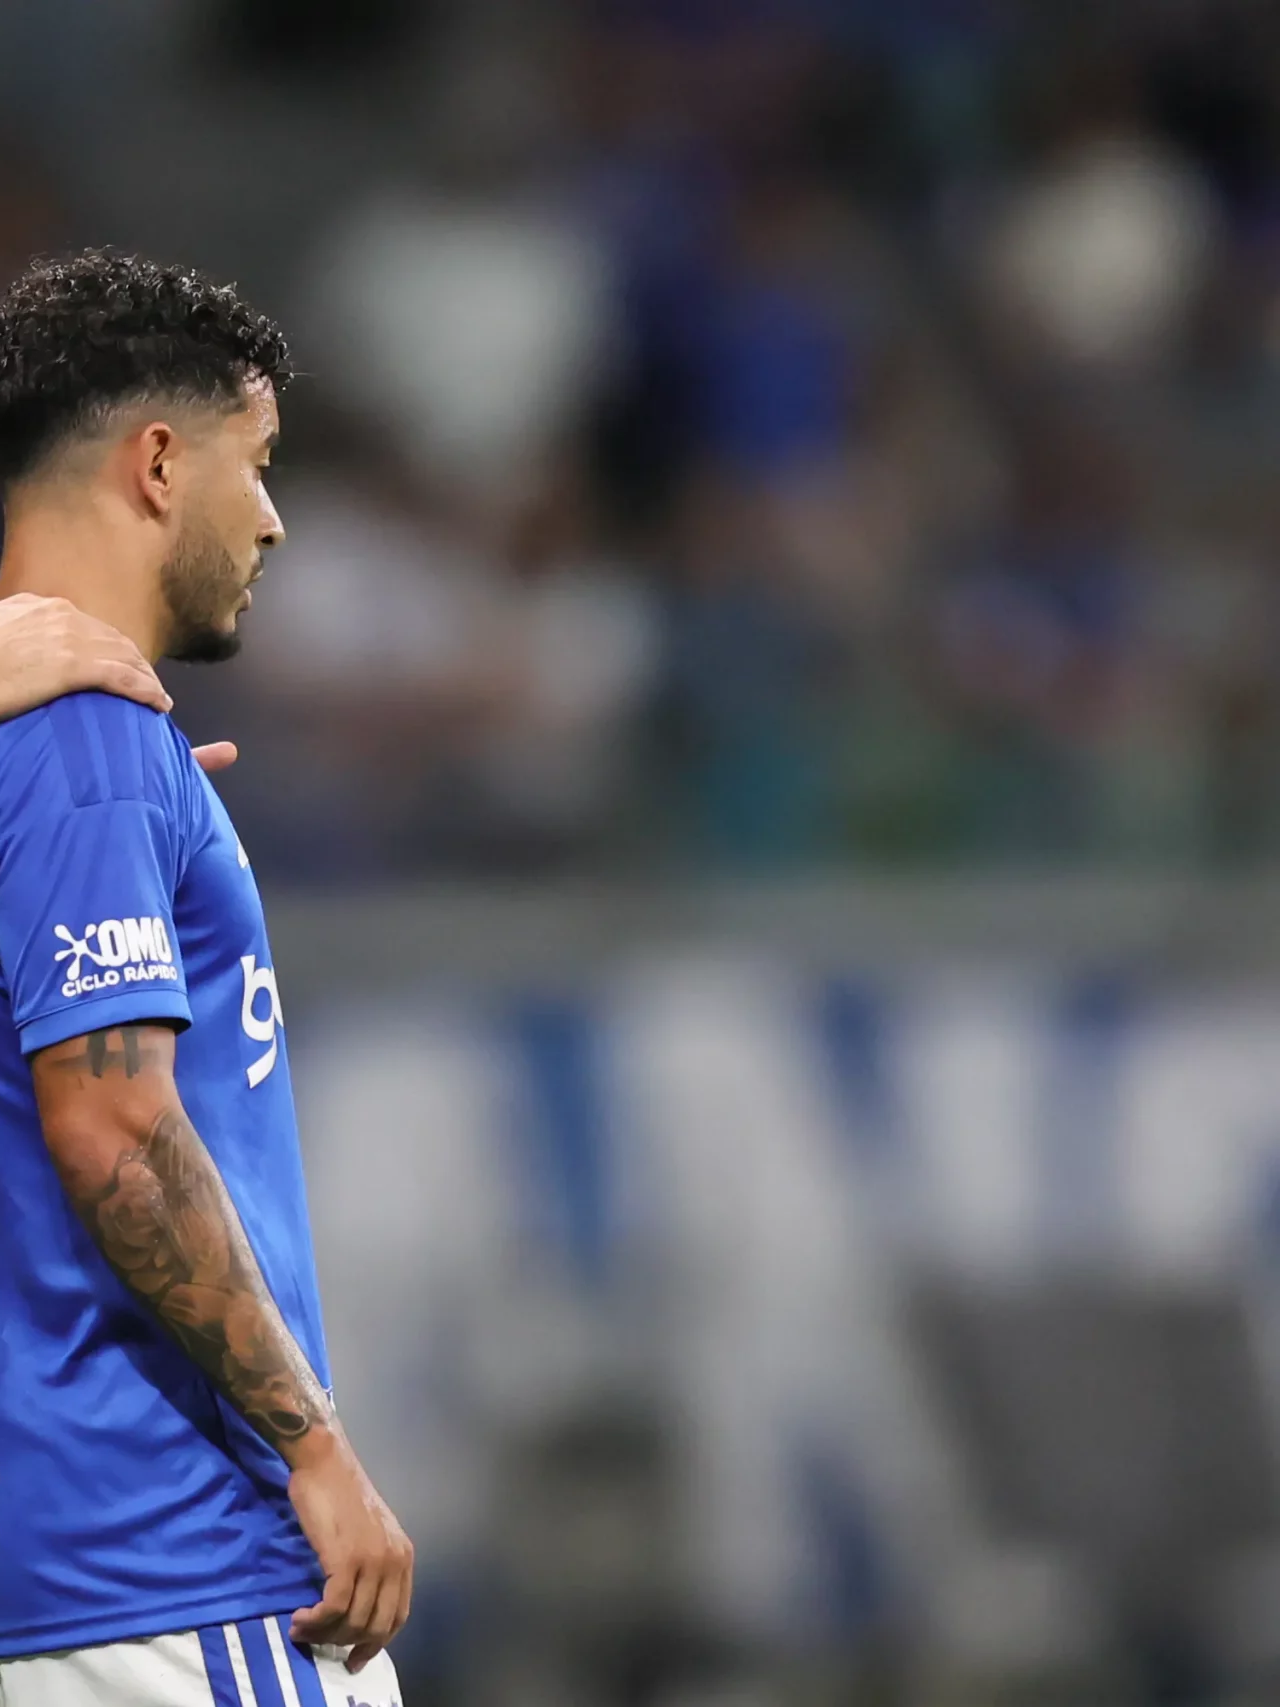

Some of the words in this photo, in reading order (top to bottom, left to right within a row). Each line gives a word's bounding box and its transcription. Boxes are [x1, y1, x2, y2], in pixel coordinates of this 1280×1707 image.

[97, 916, 173, 967] OMO
[61, 970, 121, 998] CICLO
[123, 962, 179, 983] RÁPIDO
